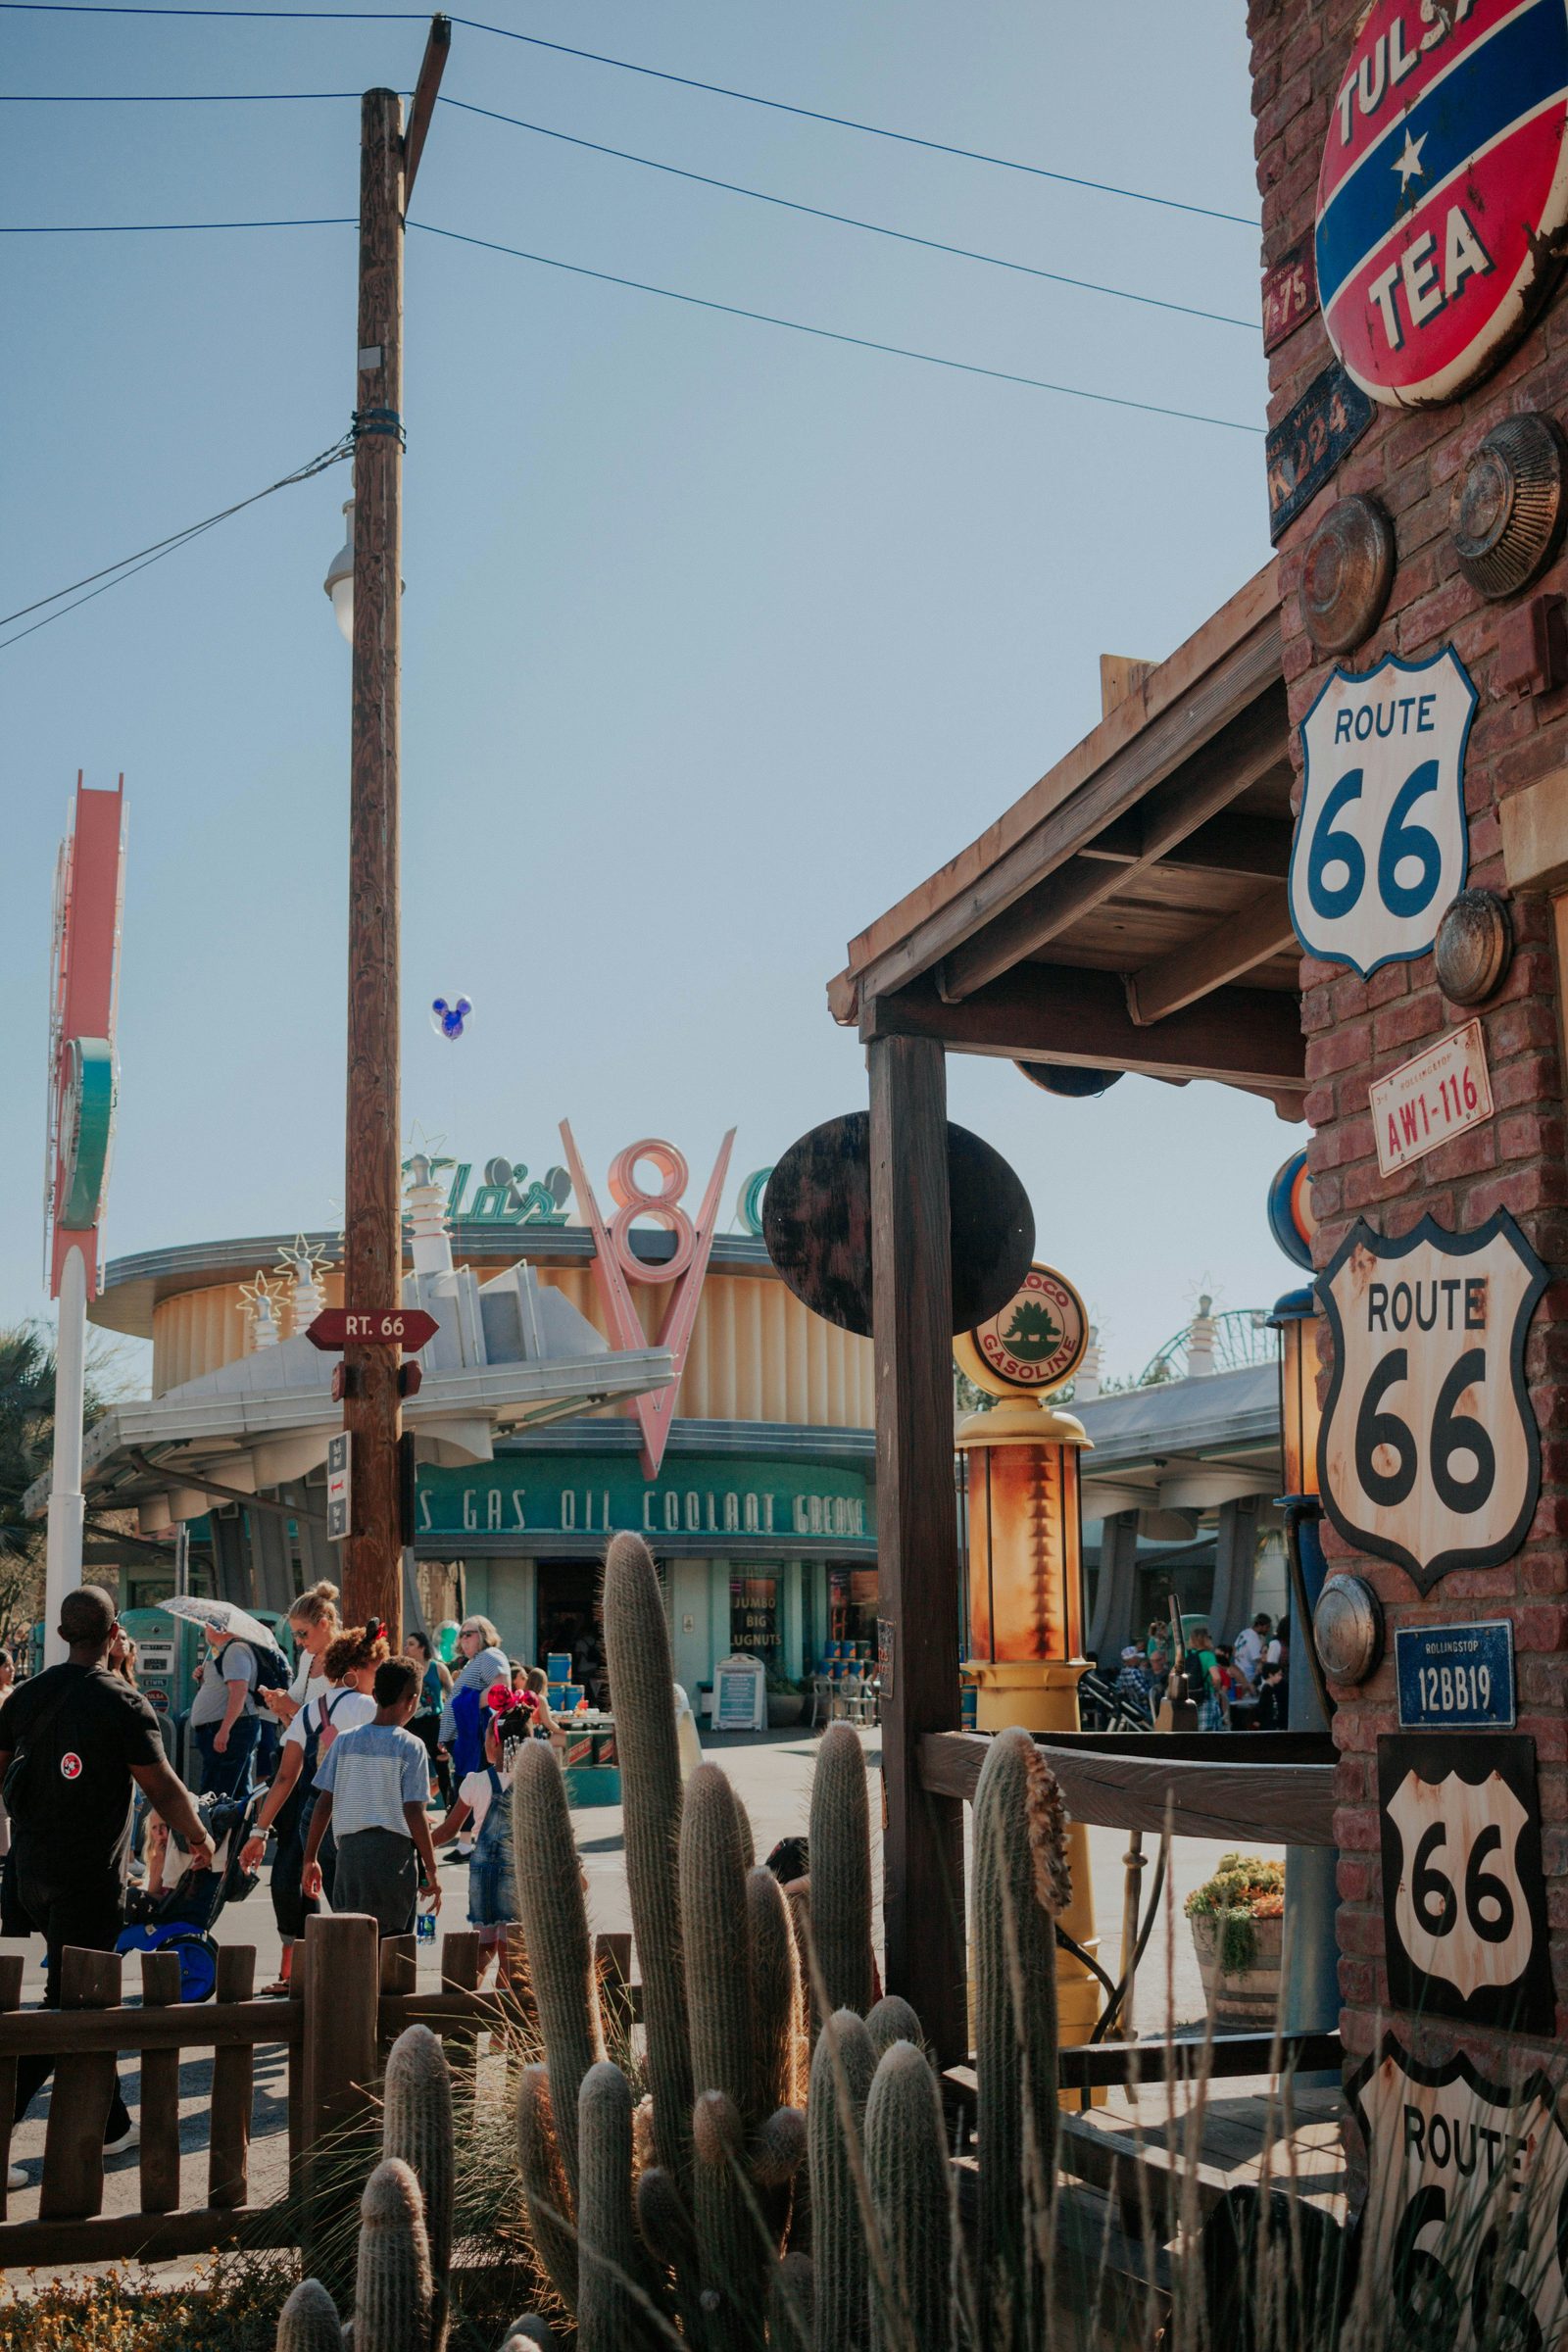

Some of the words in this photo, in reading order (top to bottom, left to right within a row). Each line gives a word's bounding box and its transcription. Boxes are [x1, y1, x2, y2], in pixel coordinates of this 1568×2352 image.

[1368, 204, 1494, 351] TEA
[1334, 693, 1438, 745] ROUTE
[1307, 759, 1442, 920] 66
[1388, 1065, 1478, 1156] AW1-116
[1020, 1275, 1069, 1307] OCO
[1368, 1278, 1487, 1333] ROUTE
[346, 1315, 373, 1336] RT.
[380, 1316, 405, 1337] 66
[983, 1334, 1077, 1380] GASOLINE
[1355, 1348, 1496, 1515] 66
[463, 1489, 525, 1531] GAS
[561, 1489, 613, 1531] OIL
[734, 1597, 776, 1609] JUMBO
[746, 1615, 766, 1628] BIG
[1425, 1641, 1479, 1654] ROLLINGSTOP
[1418, 1664, 1491, 1711] 12BB19
[1411, 1821, 1515, 1943] 66
